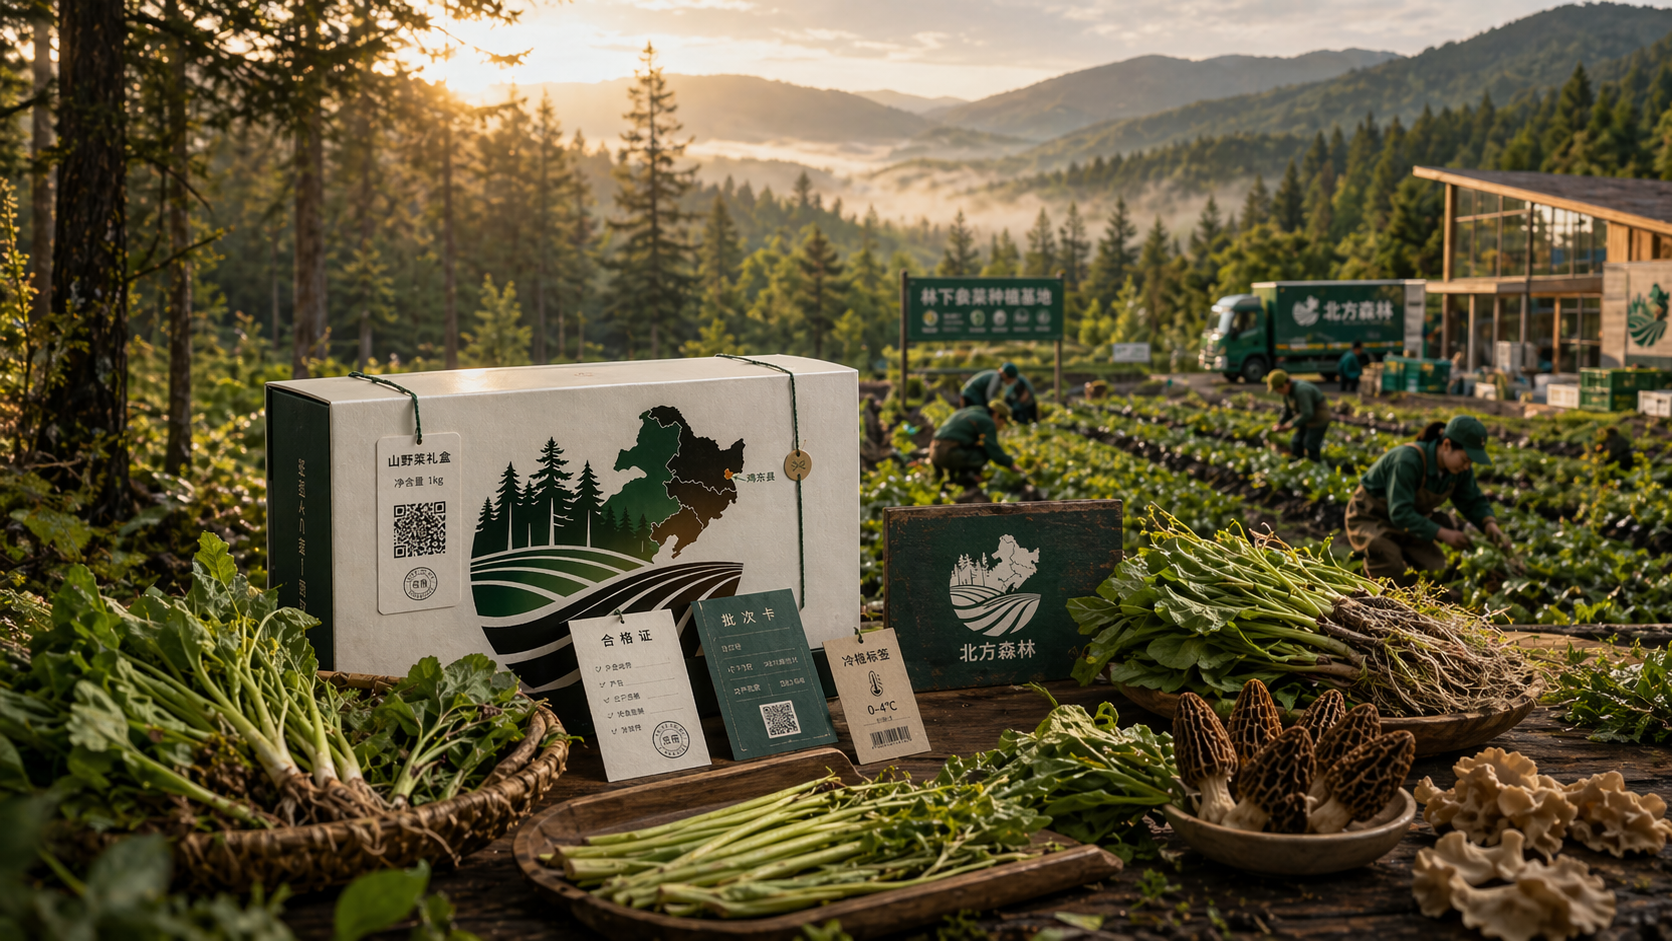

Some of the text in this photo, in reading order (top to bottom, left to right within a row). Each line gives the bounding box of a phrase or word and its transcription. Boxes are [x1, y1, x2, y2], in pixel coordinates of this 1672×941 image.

[1323, 299, 1394, 321] 北方森林
[394, 475, 444, 489] 净含量 1kg
[720, 607, 775, 628] 批次卡
[601, 629, 653, 648] 合格证
[959, 639, 1036, 663] 北方森林
